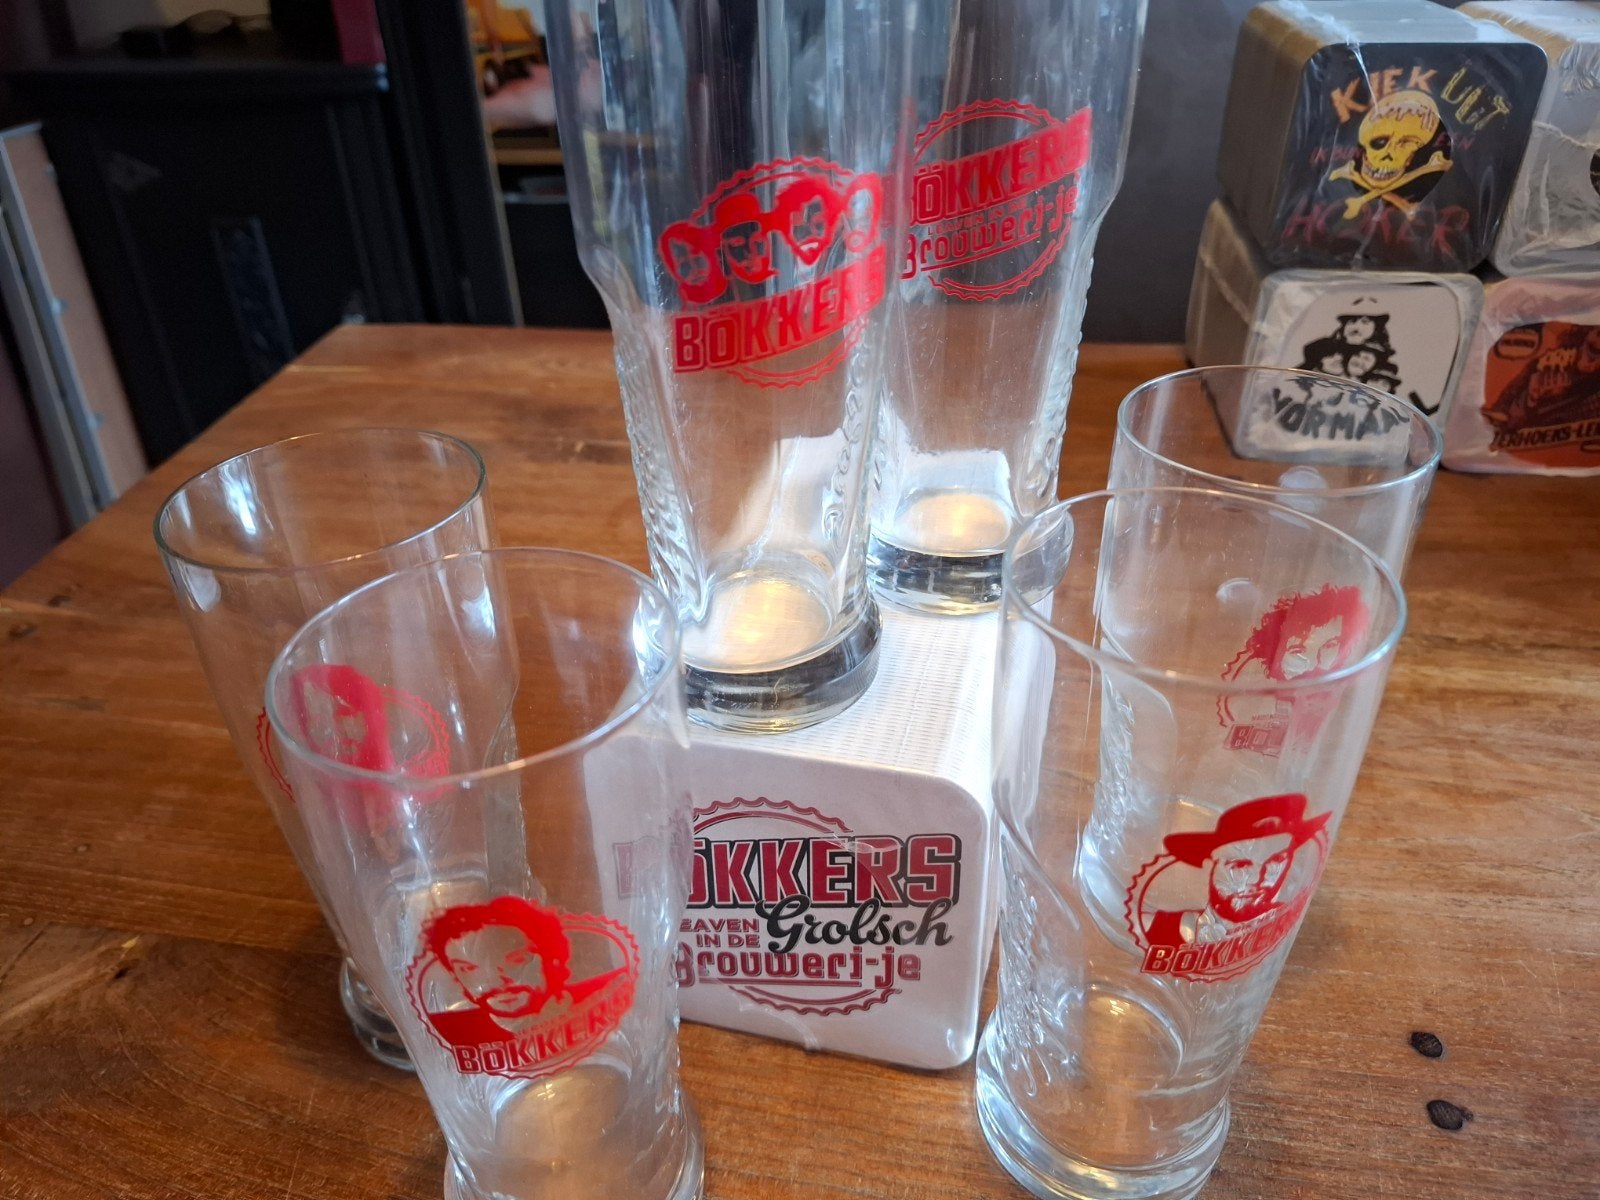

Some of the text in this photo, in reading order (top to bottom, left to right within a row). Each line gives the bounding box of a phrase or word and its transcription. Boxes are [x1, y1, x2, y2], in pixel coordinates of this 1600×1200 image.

[911, 108, 1092, 226] ÖKKERS
[686, 833, 962, 909] ÖKKERS
[677, 894, 955, 955] EAVEN Grolsch
[696, 933, 760, 948] IN DE
